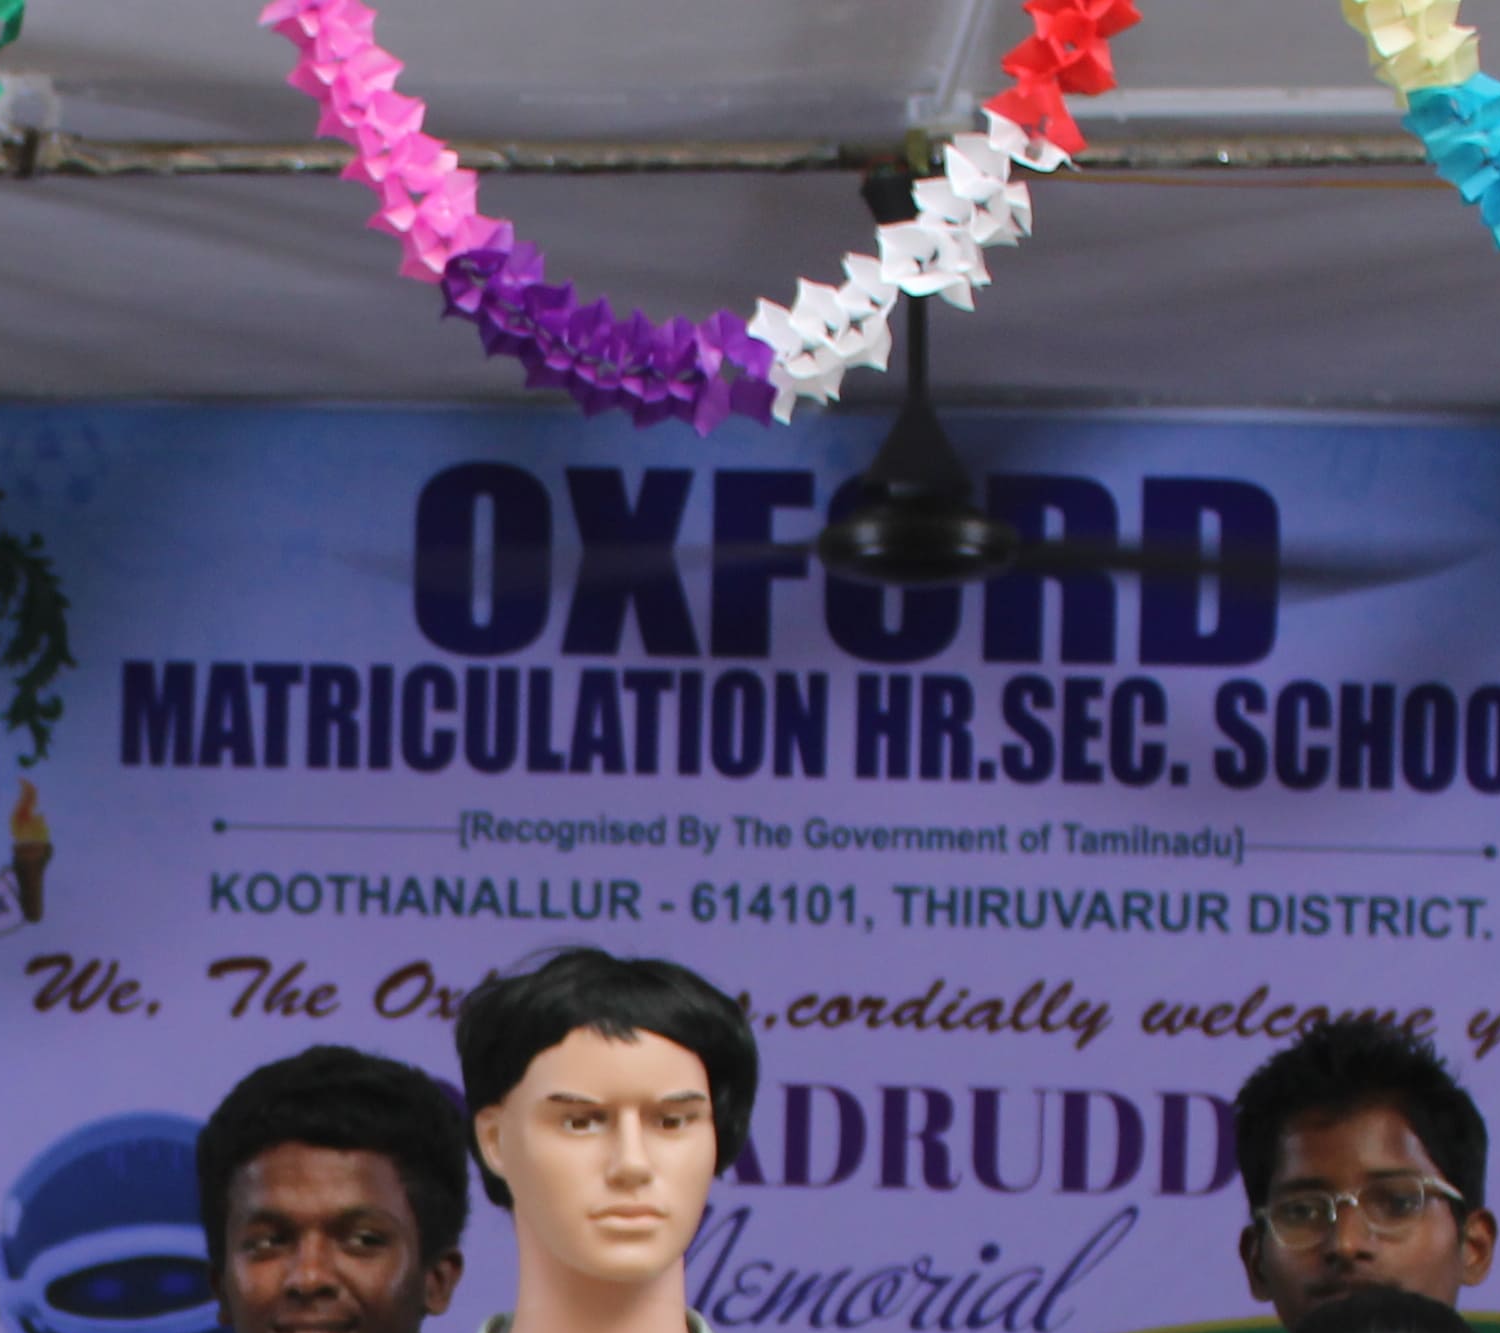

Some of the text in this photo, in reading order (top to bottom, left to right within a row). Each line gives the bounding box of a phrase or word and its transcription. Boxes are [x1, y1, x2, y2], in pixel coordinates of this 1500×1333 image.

[121, 661, 828, 779] MATRICULATION
[676, 815, 720, 854] By
[731, 817, 792, 850] The
[803, 818, 1008, 854] Government
[1018, 820, 1051, 853] of
[209, 872, 643, 922] KOOTHANALLUR
[691, 880, 875, 932] 614101,
[892, 885, 1230, 934] THIRUVARUR
[1250, 892, 1494, 942] DISTRICT.
[206, 956, 341, 1020] The
